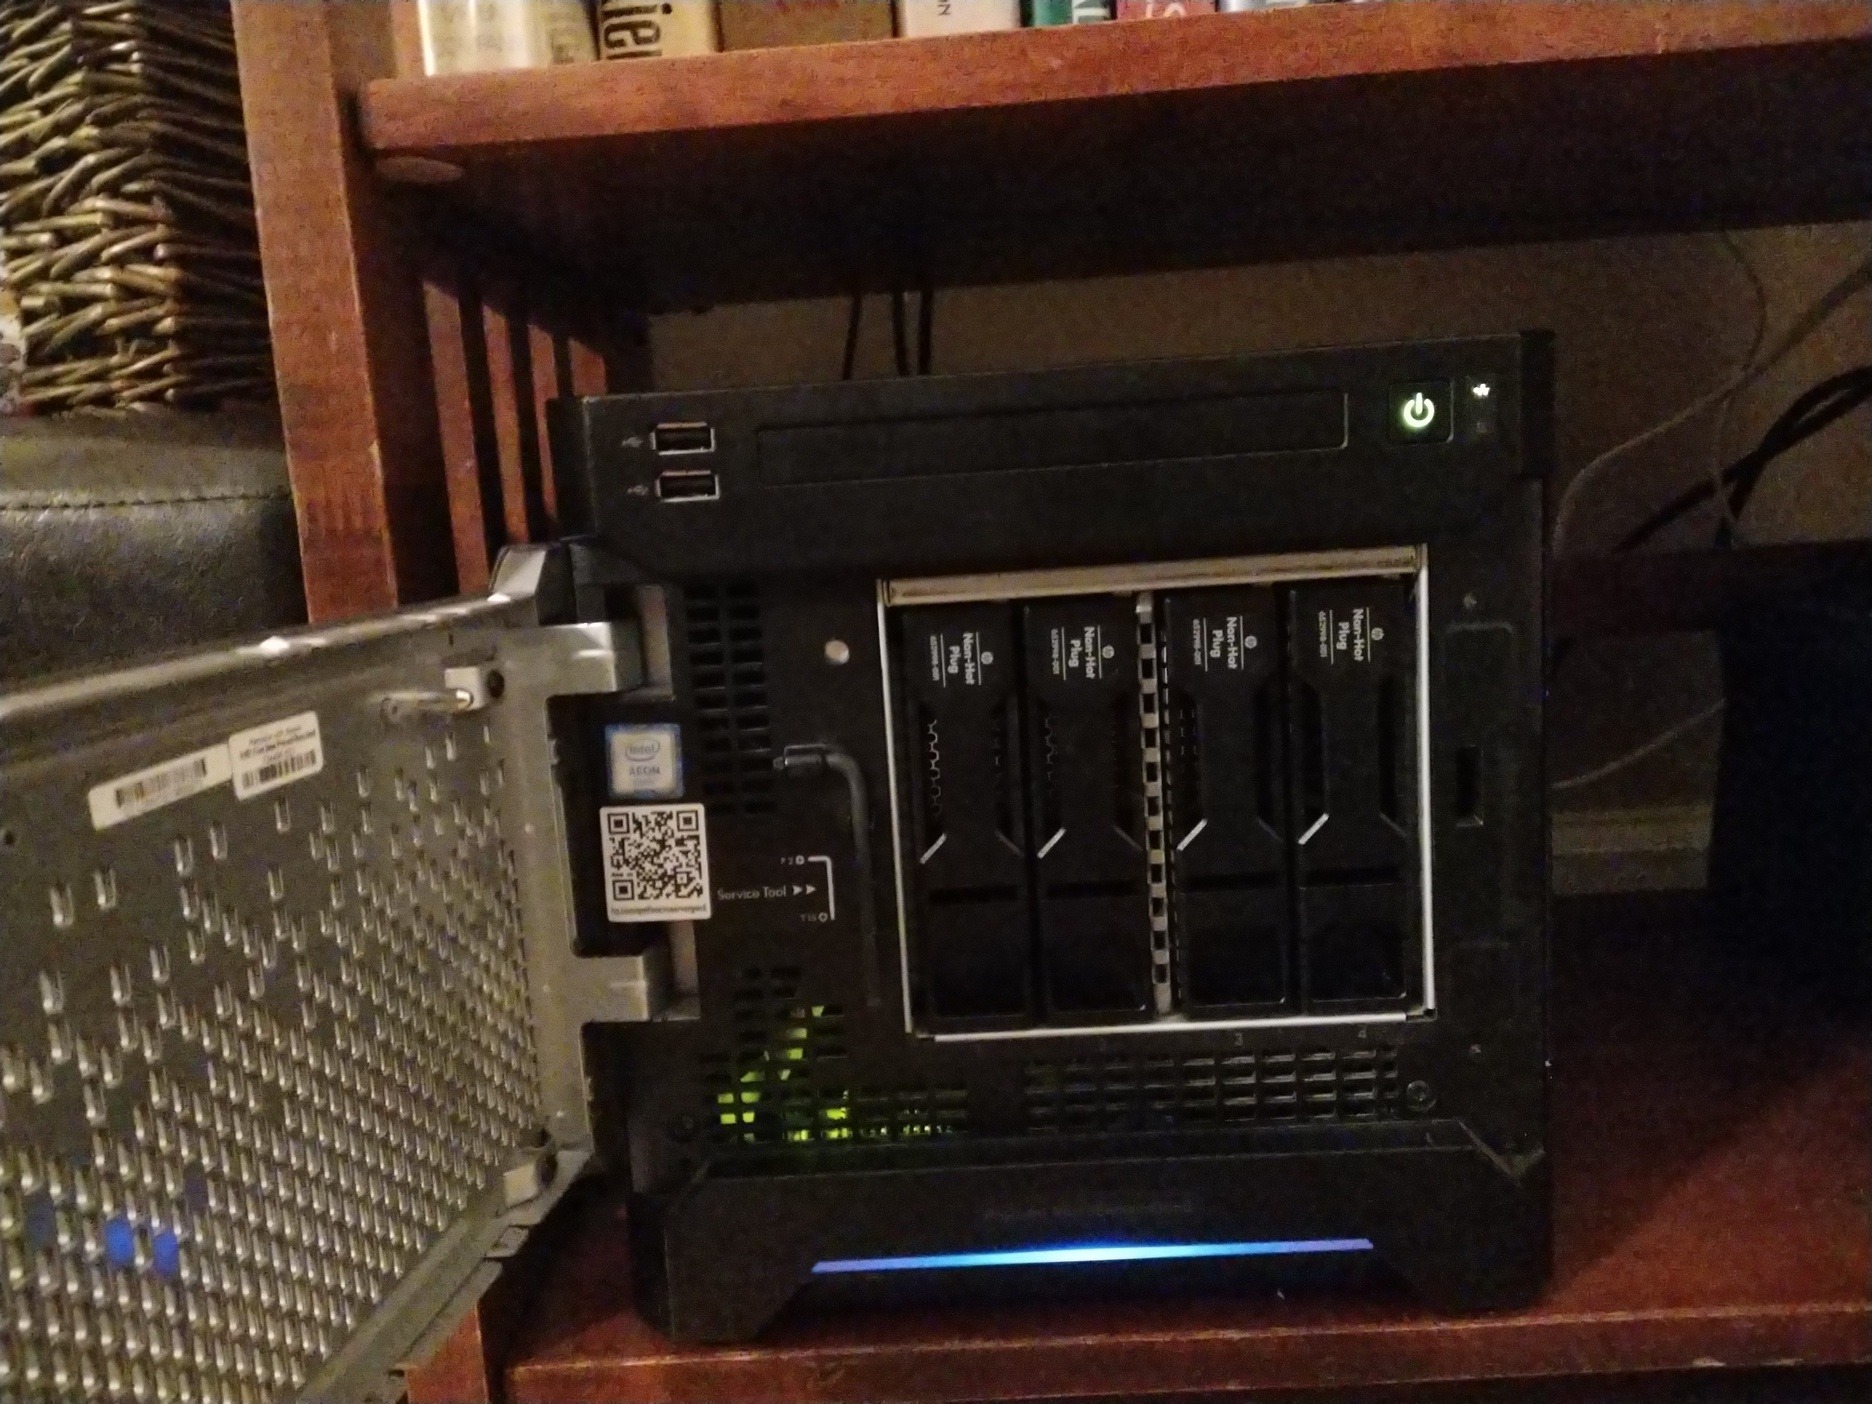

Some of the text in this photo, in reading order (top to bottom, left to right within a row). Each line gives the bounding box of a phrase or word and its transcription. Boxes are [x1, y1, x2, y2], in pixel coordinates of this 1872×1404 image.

[1210, 629, 1224, 658] Plug
[1226, 616, 1238, 669] Non-Hot
[1336, 622, 1350, 650] Plug
[1352, 608, 1366, 661] Non-Hot
[947, 645, 961, 674] Plug
[963, 632, 976, 685] Non-Hot
[1068, 639, 1082, 668] Plug
[1084, 626, 1097, 679] Non-Hot
[717, 885, 786, 900] Service Tool
